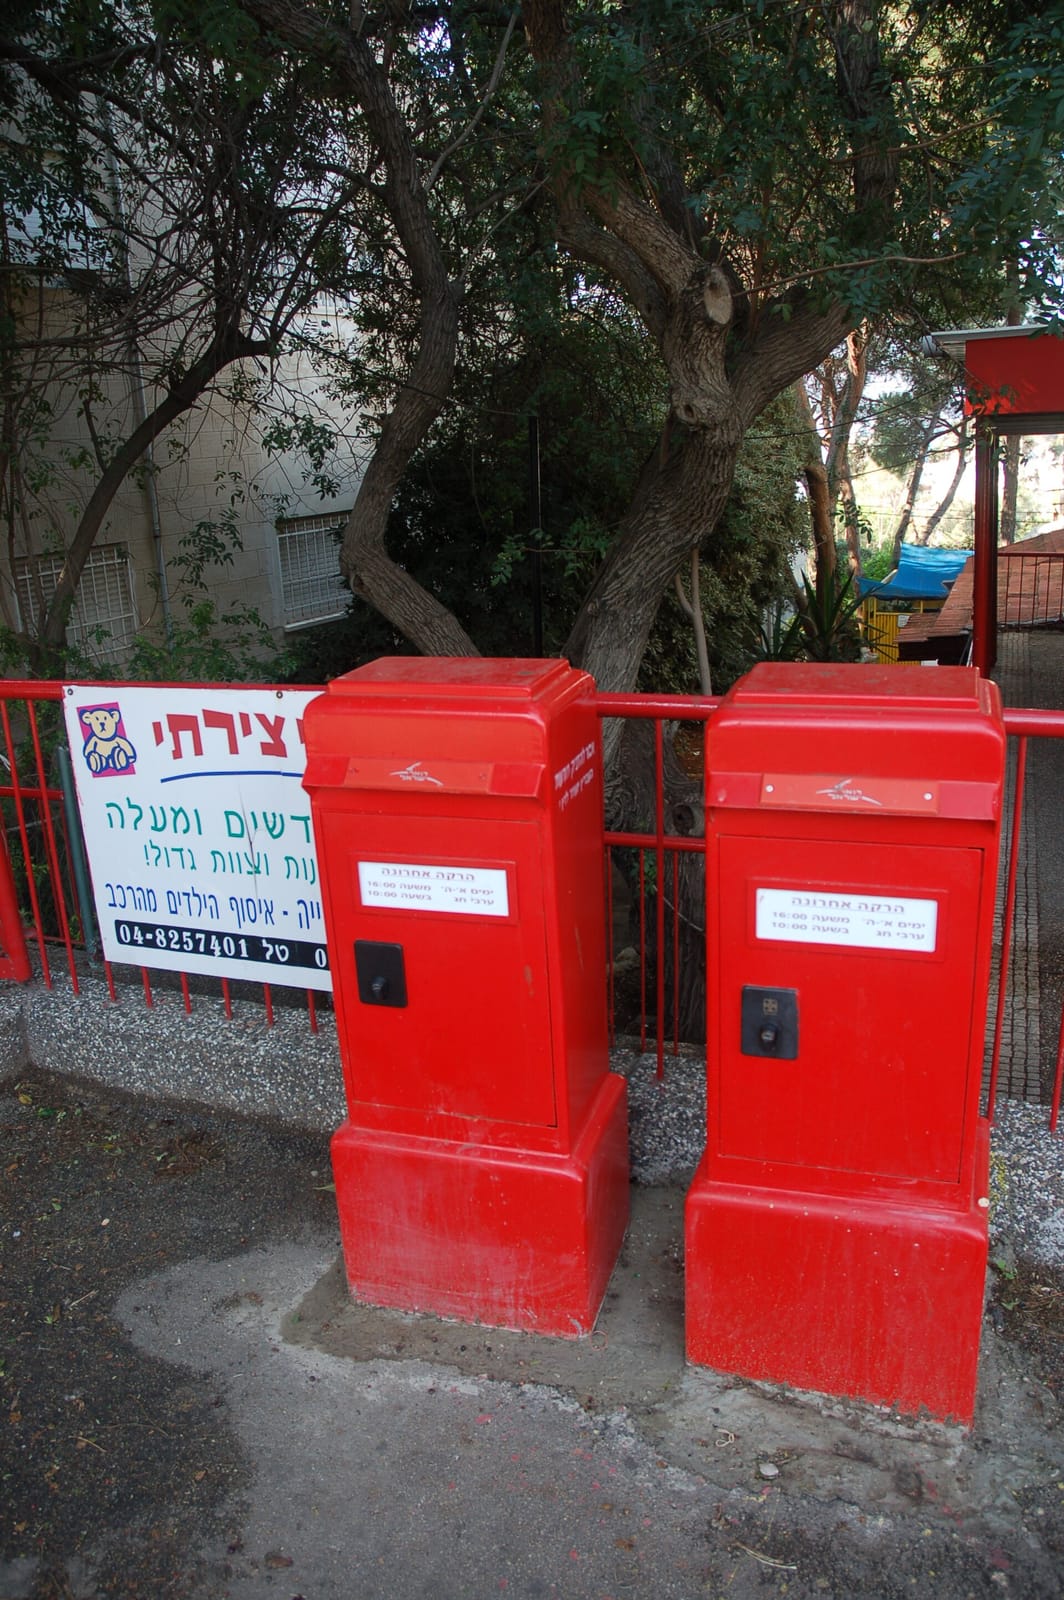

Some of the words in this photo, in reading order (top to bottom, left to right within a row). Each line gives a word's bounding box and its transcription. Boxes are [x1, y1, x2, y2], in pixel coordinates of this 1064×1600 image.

[105, 797, 202, 836] ומעלה
[224, 810, 311, 843] דשים
[144, 839, 197, 871] גדול!
[211, 850, 270, 876] וצוות
[284, 855, 317, 885] נות
[381, 867, 431, 878] אחרונה
[368, 880, 396, 889] 16:00
[368, 890, 397, 898] 10:00
[105, 883, 158, 913] מהרכב
[166, 886, 220, 920] הילדים
[792, 897, 851, 909] אחרונה
[858, 901, 905, 913] הרקה
[229, 896, 275, 929] איסוף
[773, 911, 808, 920] 16:00
[772, 922, 808, 931] 10:00
[896, 932, 925, 940] ערבי
[119, 924, 249, 958] 04-8257401
[261, 939, 289, 962] טל
